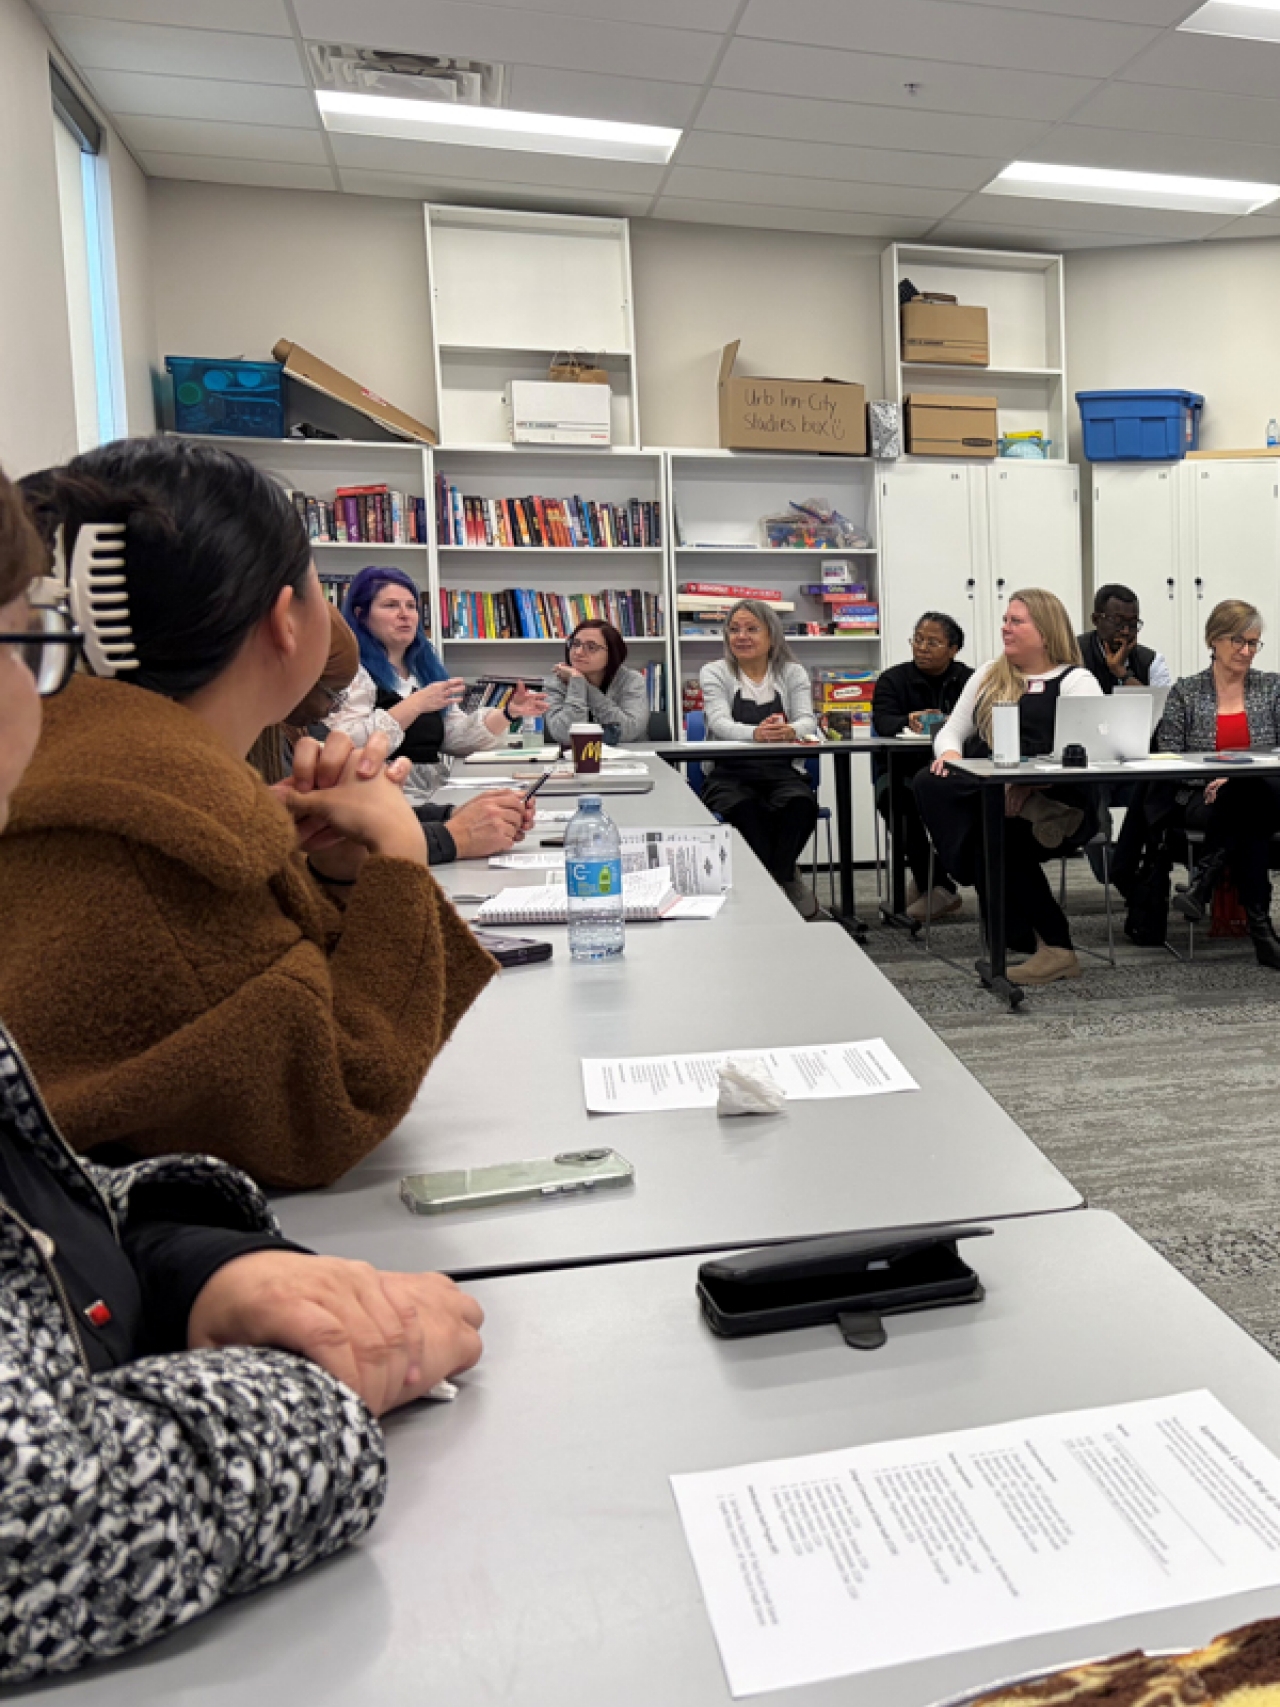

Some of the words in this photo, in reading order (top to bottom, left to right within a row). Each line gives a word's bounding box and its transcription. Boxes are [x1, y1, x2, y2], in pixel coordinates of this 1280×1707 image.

[743, 388, 775, 407] Urb
[742, 412, 797, 433] Studies
[801, 414, 831, 437] box
